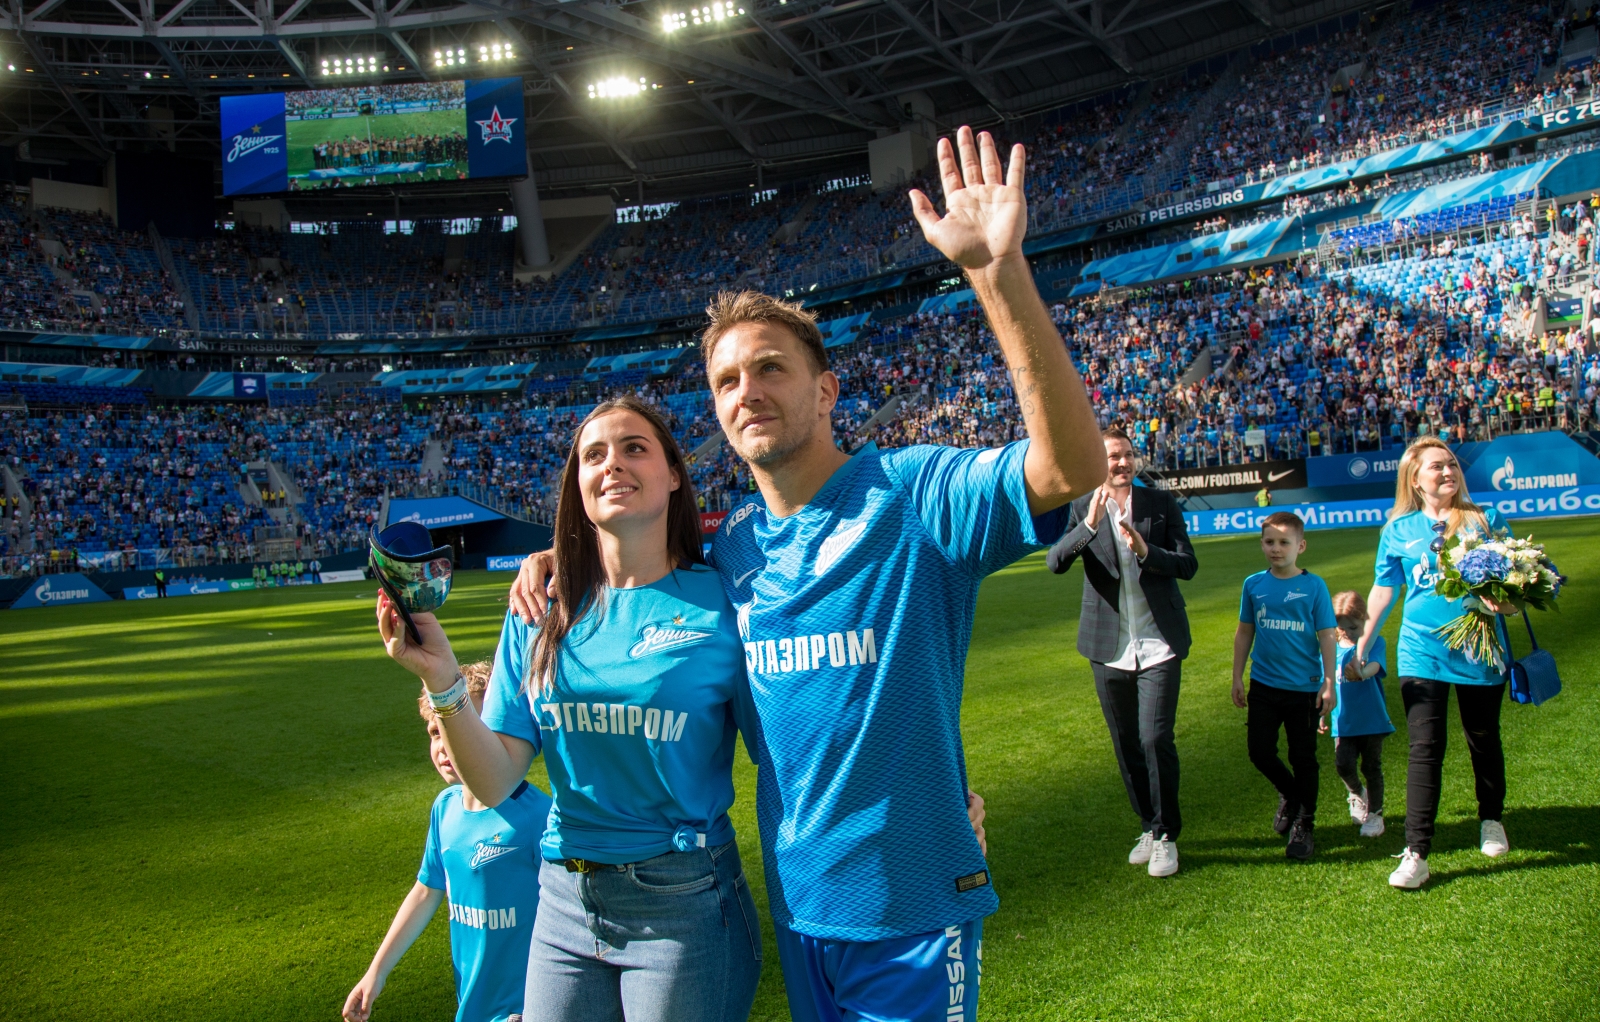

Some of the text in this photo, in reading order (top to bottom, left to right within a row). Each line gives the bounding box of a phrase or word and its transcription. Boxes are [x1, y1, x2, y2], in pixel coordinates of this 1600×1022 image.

[1542, 100, 1600, 128] FC ZE
[1106, 189, 1244, 232] SAINT PETERSBURG
[179, 340, 301, 352] SAINT PETERSBURG
[498, 335, 546, 346] FC ZENIT
[1373, 460, 1400, 473] ГАЗП
[1516, 473, 1578, 490] GAZPROM
[421, 512, 474, 525] ГАЗПРОМ
[52, 589, 89, 600] ГАЗПРОМ
[1266, 618, 1305, 632] ГАЗПРОМ
[631, 626, 714, 657] Зенит
[756, 628, 877, 675] ГАЗПРОМ
[562, 702, 689, 742] ГАЗПРОМ
[453, 903, 517, 930] ГАЗПРОМ
